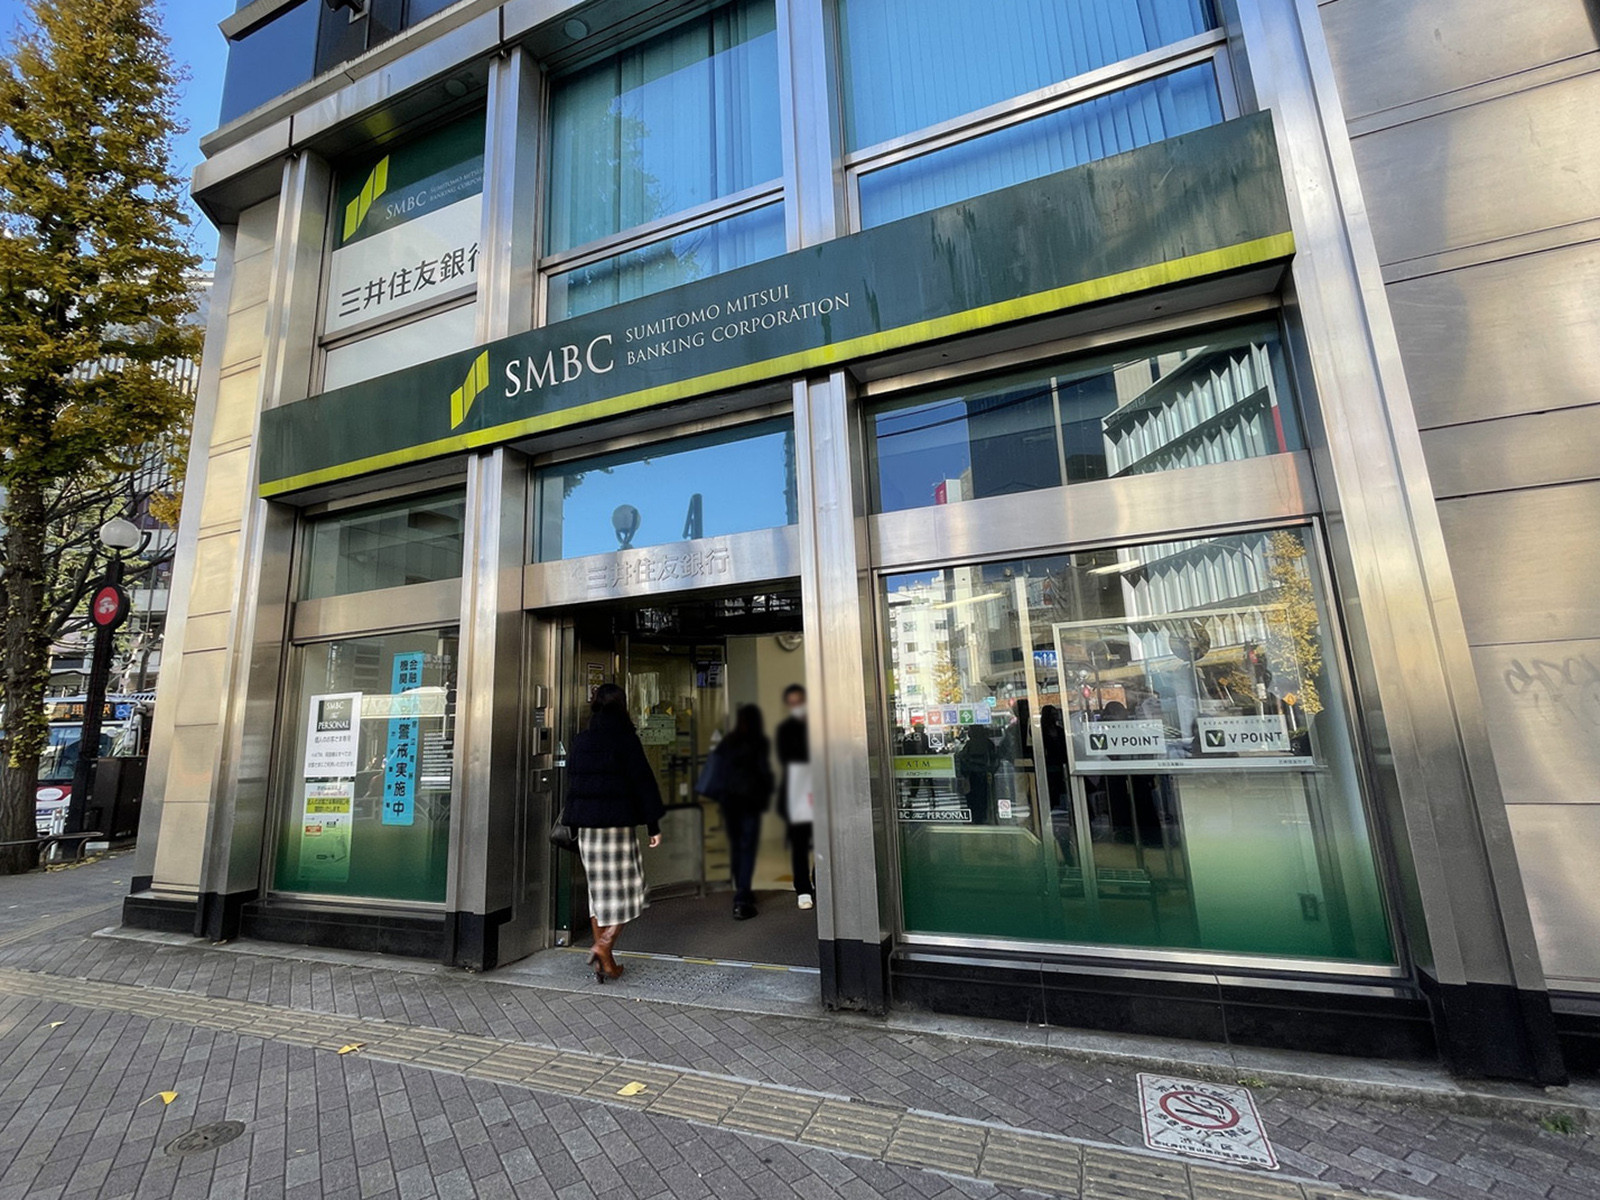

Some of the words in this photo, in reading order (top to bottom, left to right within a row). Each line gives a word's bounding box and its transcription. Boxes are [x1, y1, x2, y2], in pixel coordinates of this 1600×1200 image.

[385, 191, 427, 220] SMBC
[625, 304, 720, 343] SUMITOMO
[726, 283, 790, 315] MITSUI
[626, 333, 705, 366] BANKING
[711, 293, 851, 343] CORPORATION
[504, 334, 614, 397] SMBC
[586, 547, 730, 590] 三井住友銀行
[326, 701, 344, 710] SMBC
[318, 720, 349, 730] PERSONAL
[1110, 737, 1118, 746] V
[1122, 735, 1159, 747] POINT
[1229, 733, 1237, 744] V
[1241, 731, 1282, 743] POINT
[905, 760, 930, 768] ATM
[926, 811, 968, 820] PERSONAL
